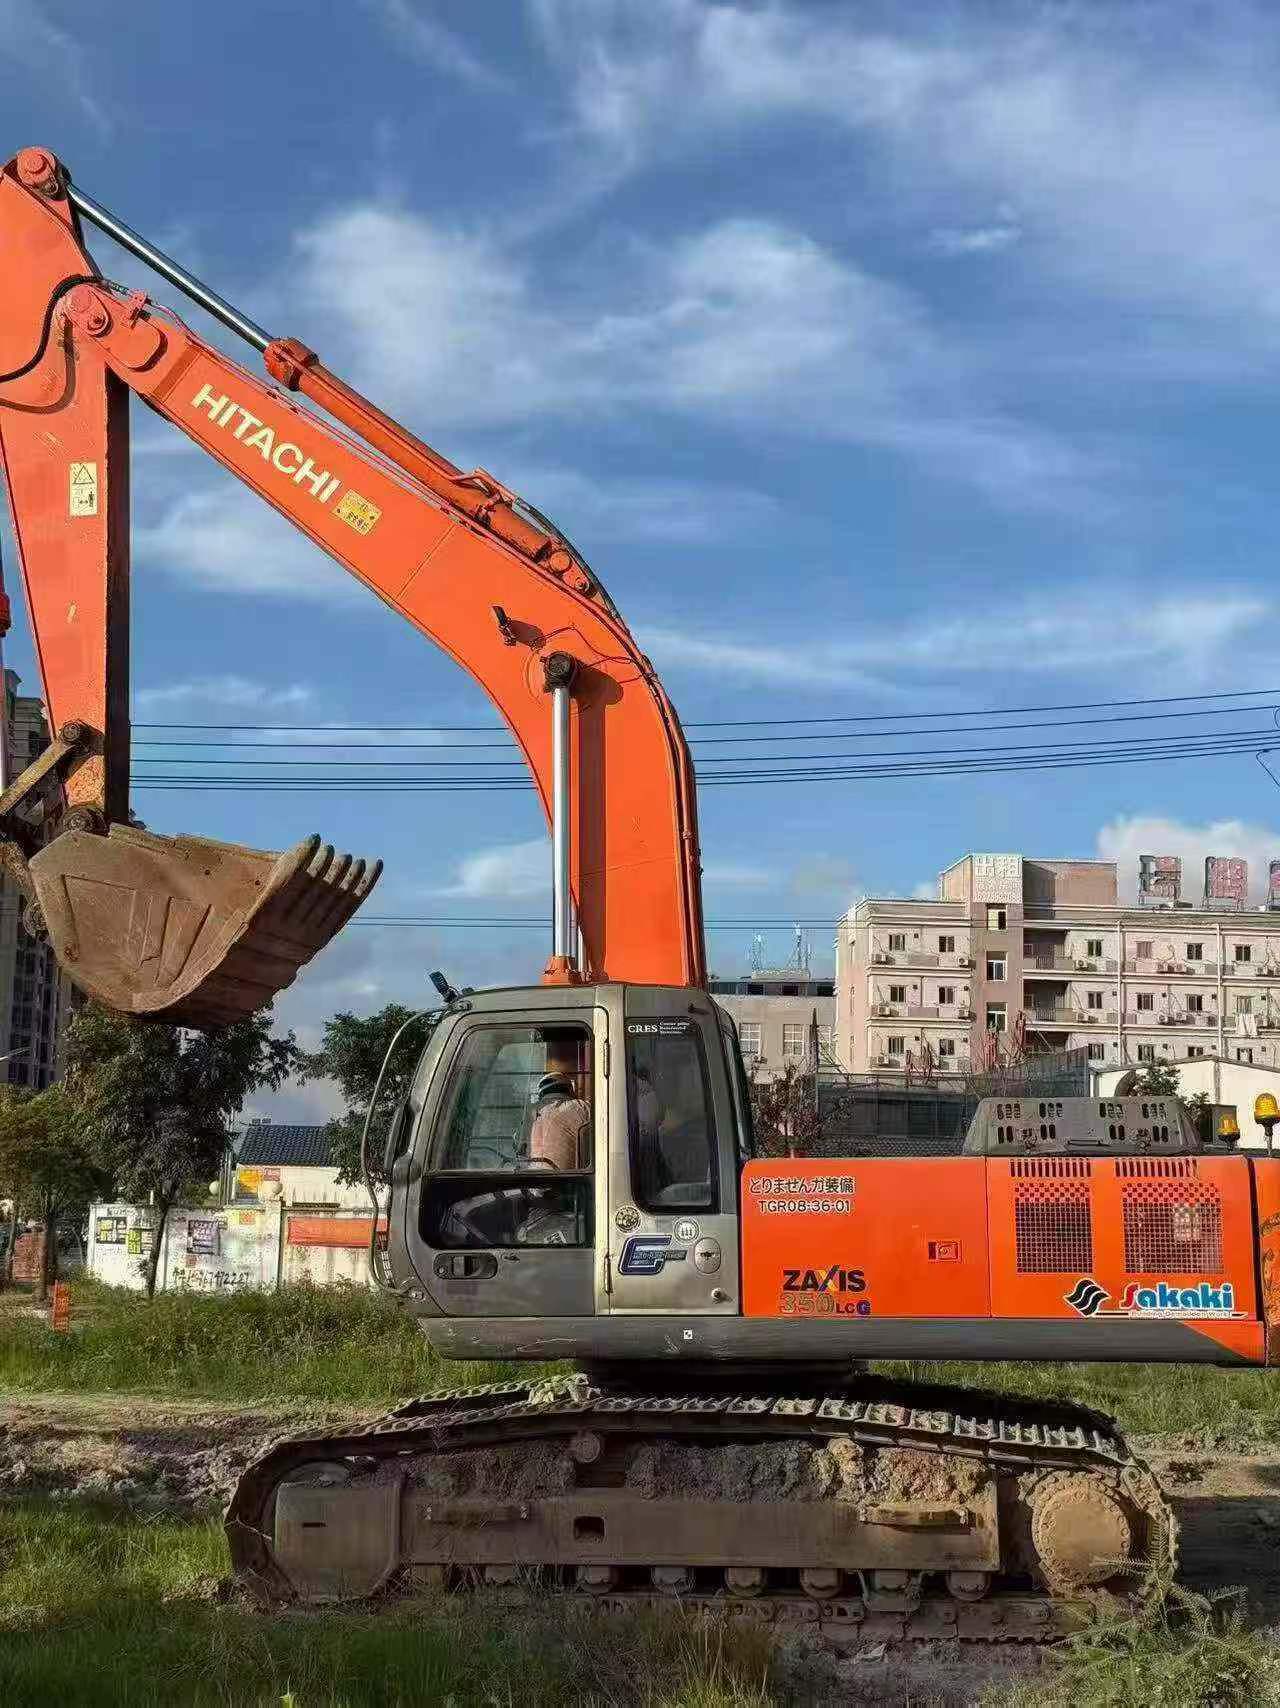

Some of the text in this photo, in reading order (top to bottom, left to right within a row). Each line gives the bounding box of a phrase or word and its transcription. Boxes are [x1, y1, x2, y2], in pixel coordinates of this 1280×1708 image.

[191, 383, 342, 504] HITACHI
[627, 1024, 658, 1033] CRES
[783, 1264, 866, 1292] ZAXIS
[1119, 1281, 1234, 1309] Sakaki
